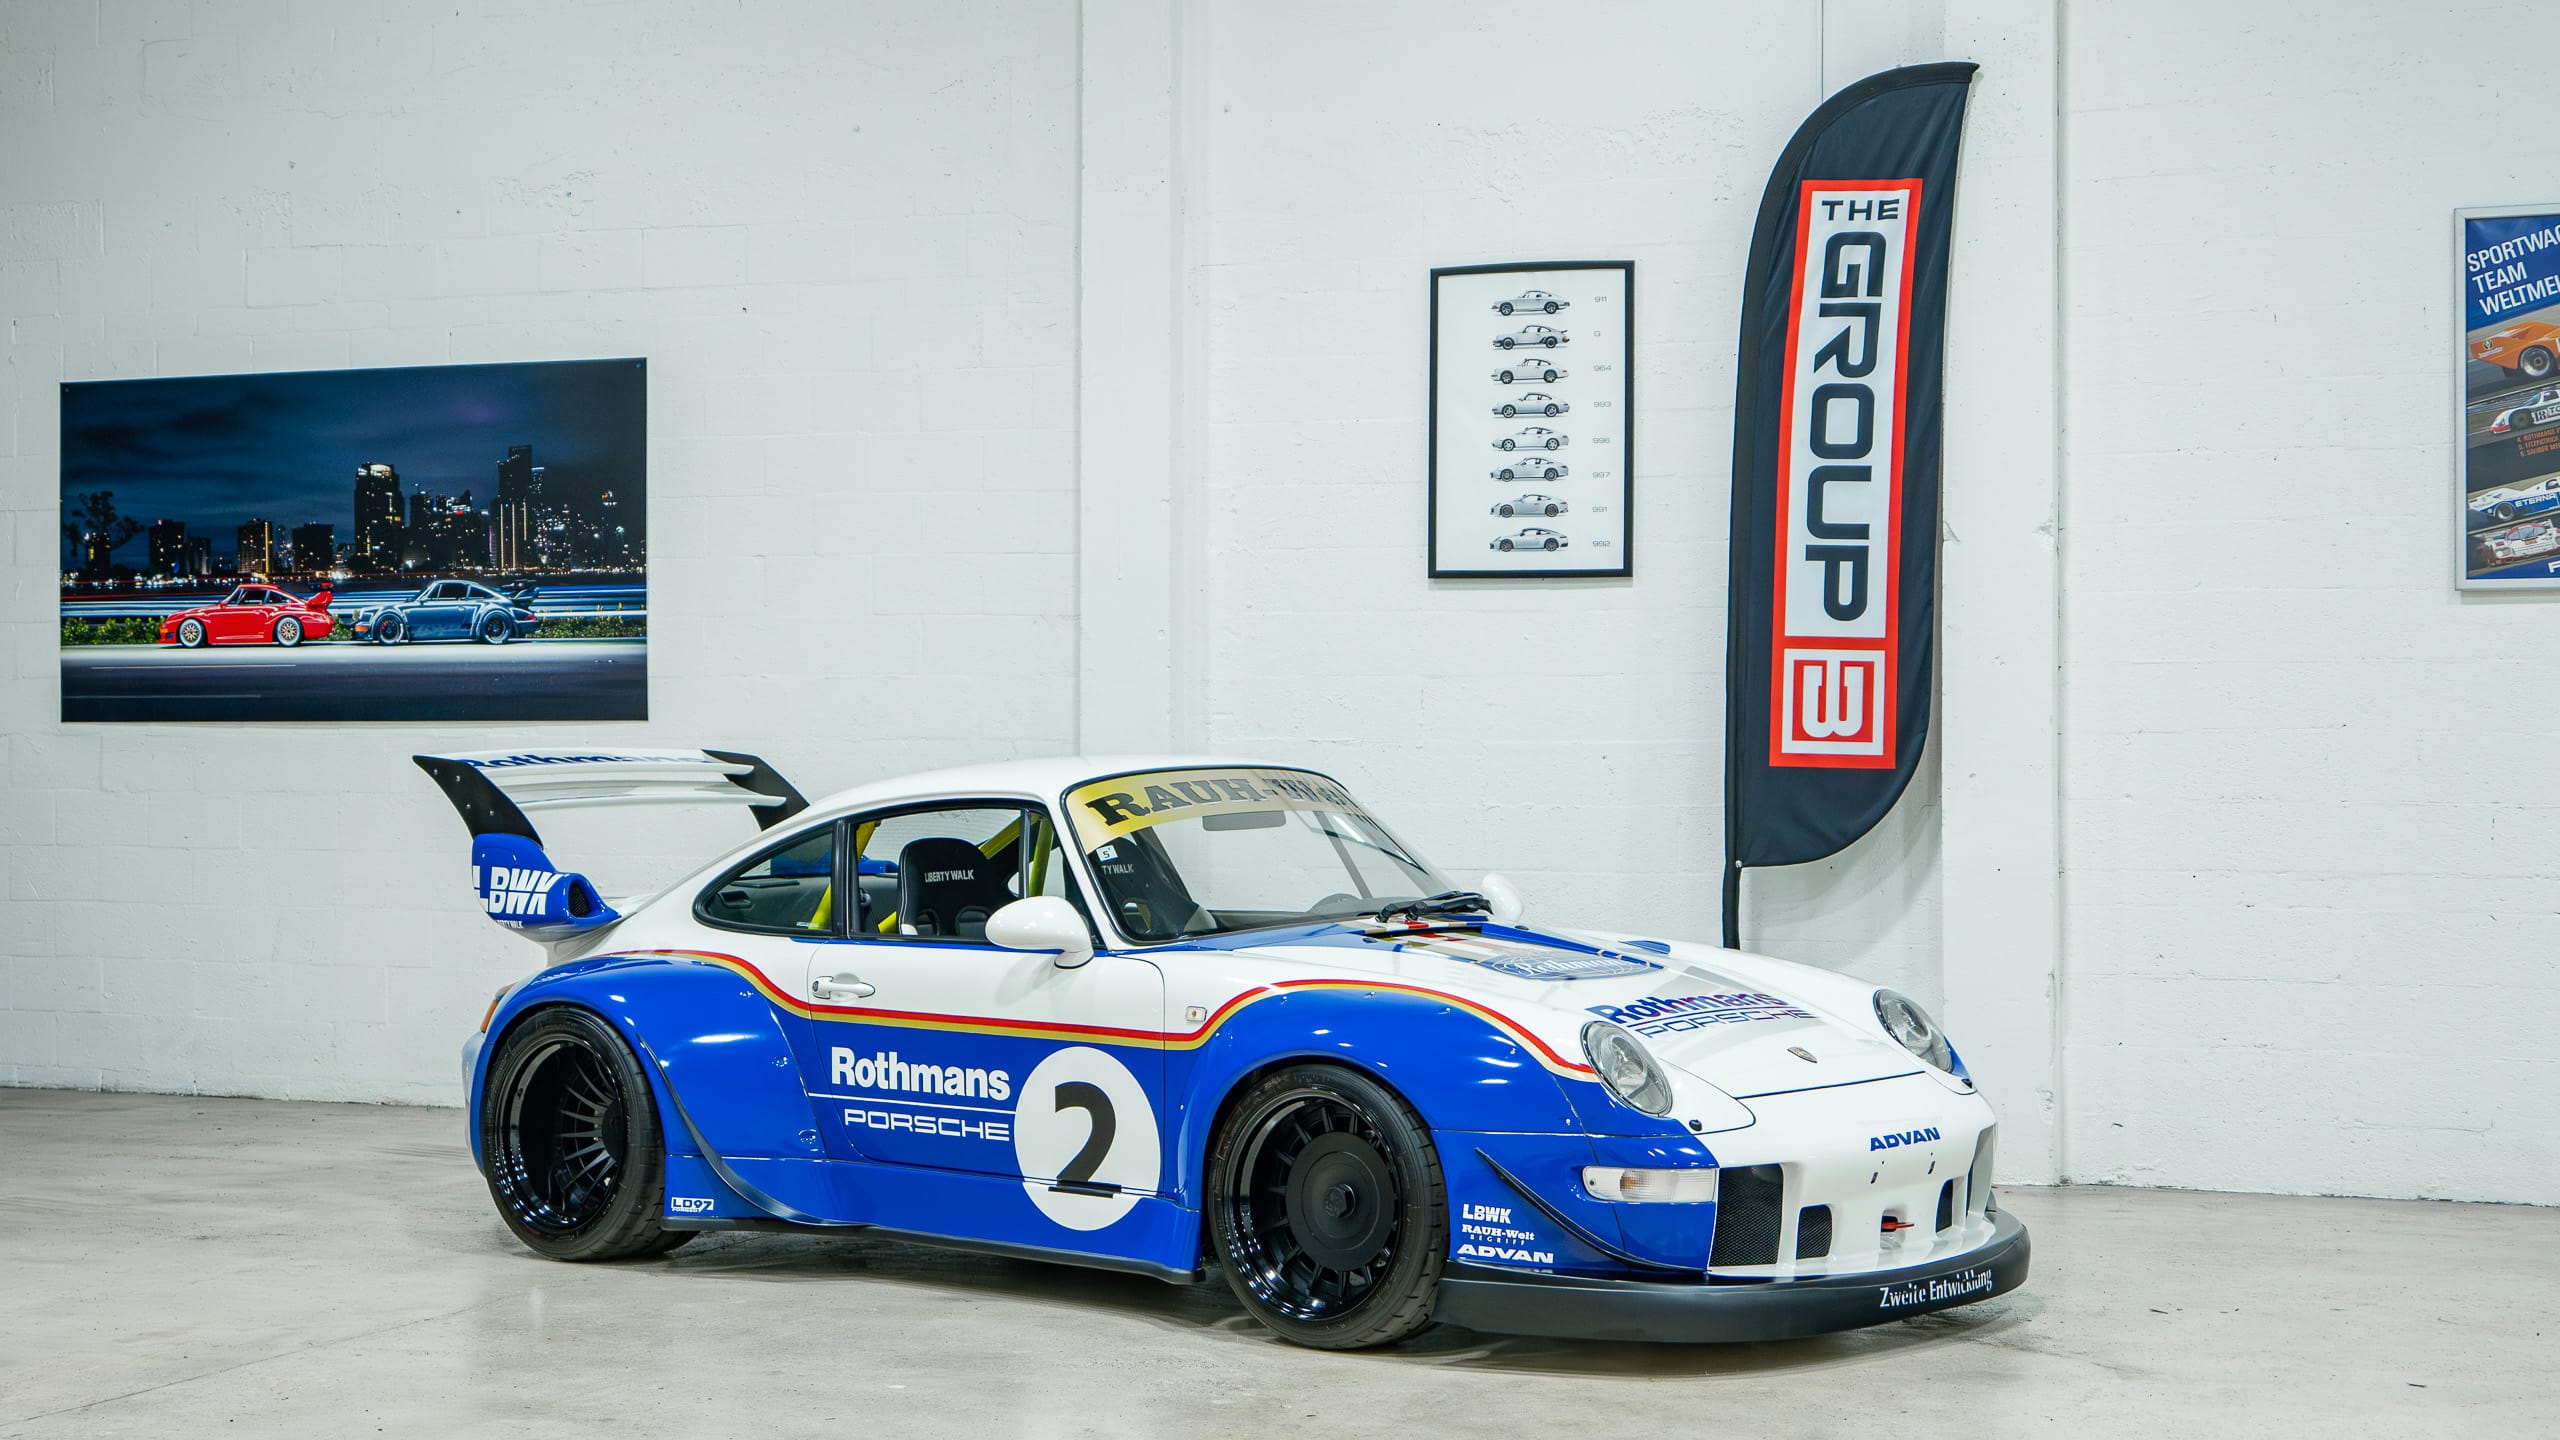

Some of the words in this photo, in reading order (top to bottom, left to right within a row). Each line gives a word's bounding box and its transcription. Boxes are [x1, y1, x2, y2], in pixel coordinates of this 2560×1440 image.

[1821, 199, 1900, 221] THE
[2472, 261, 2528, 293] TEAM
[1593, 364, 1612, 372] 964
[1593, 400, 1612, 408] 993
[1805, 231, 1887, 622] GROUP
[1801, 663, 1865, 739] 3
[924, 871, 949, 883] LIBERTY
[950, 869, 975, 881] WALK
[1112, 863, 1135, 875] WALK
[1584, 993, 1790, 1025] Rothmans
[1635, 1009, 1817, 1039] PORSCHE
[831, 1046, 1011, 1101] Rothmans
[844, 1108, 1010, 1142] PORSCHE
[1048, 1081, 1123, 1199] 2
[1870, 1126, 1941, 1152] ADVAN
[673, 1198, 713, 1211] LD97
[1462, 1203, 1512, 1225] LBWK
[1461, 1223, 1535, 1241] RAUH-Welt
[1457, 1243, 1554, 1264] ADVAN
[1880, 1282, 1927, 1308] Zweite
[1929, 1268, 1993, 1301] Entwicklung
